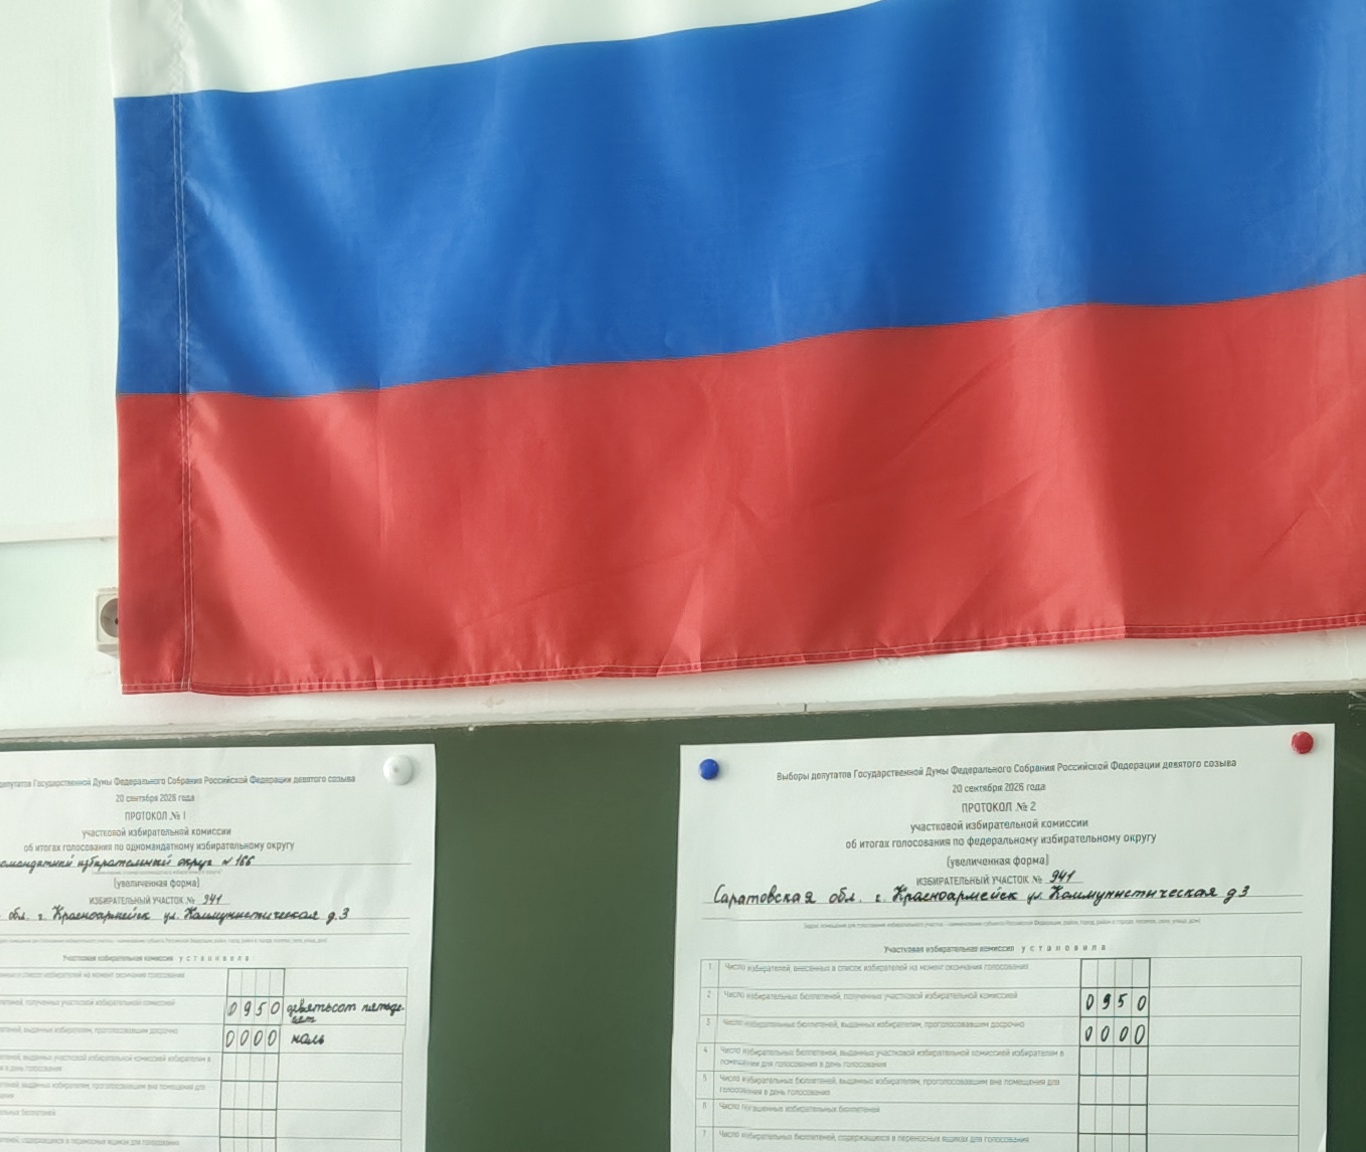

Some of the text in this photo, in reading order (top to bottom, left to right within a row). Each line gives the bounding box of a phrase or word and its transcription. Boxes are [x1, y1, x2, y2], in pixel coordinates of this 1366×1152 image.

[926, 767, 949, 776] Думы
[953, 785, 962, 793] 20
[1004, 783, 1024, 791] 2026
[962, 802, 1012, 813] ПРОТОКОЛ
[1030, 801, 1036, 811] 2
[125, 811, 167, 820] ПРОТОКОЛ
[910, 818, 1089, 833] участковой избирательной комиссии
[846, 832, 1157, 849] об итогах голосования по федеральному избирательному округу
[235, 854, 255, 866] 166
[947, 854, 1049, 869] (увеличенная форма)
[916, 874, 989, 887] ИЗБИРАТЕЛЬНЫЙ
[992, 875, 1029, 884] УЧАСТОК
[1050, 869, 1075, 883] 941
[89, 895, 151, 905] ИЗБИРАТЕЛЬНЫЙ
[153, 896, 183, 904] УЧАСТОК
[203, 894, 222, 905] 941
[714, 884, 816, 909] Саратовская
[892, 884, 1018, 906] Красноармейск
[1049, 885, 1217, 906] Коммунистическая
